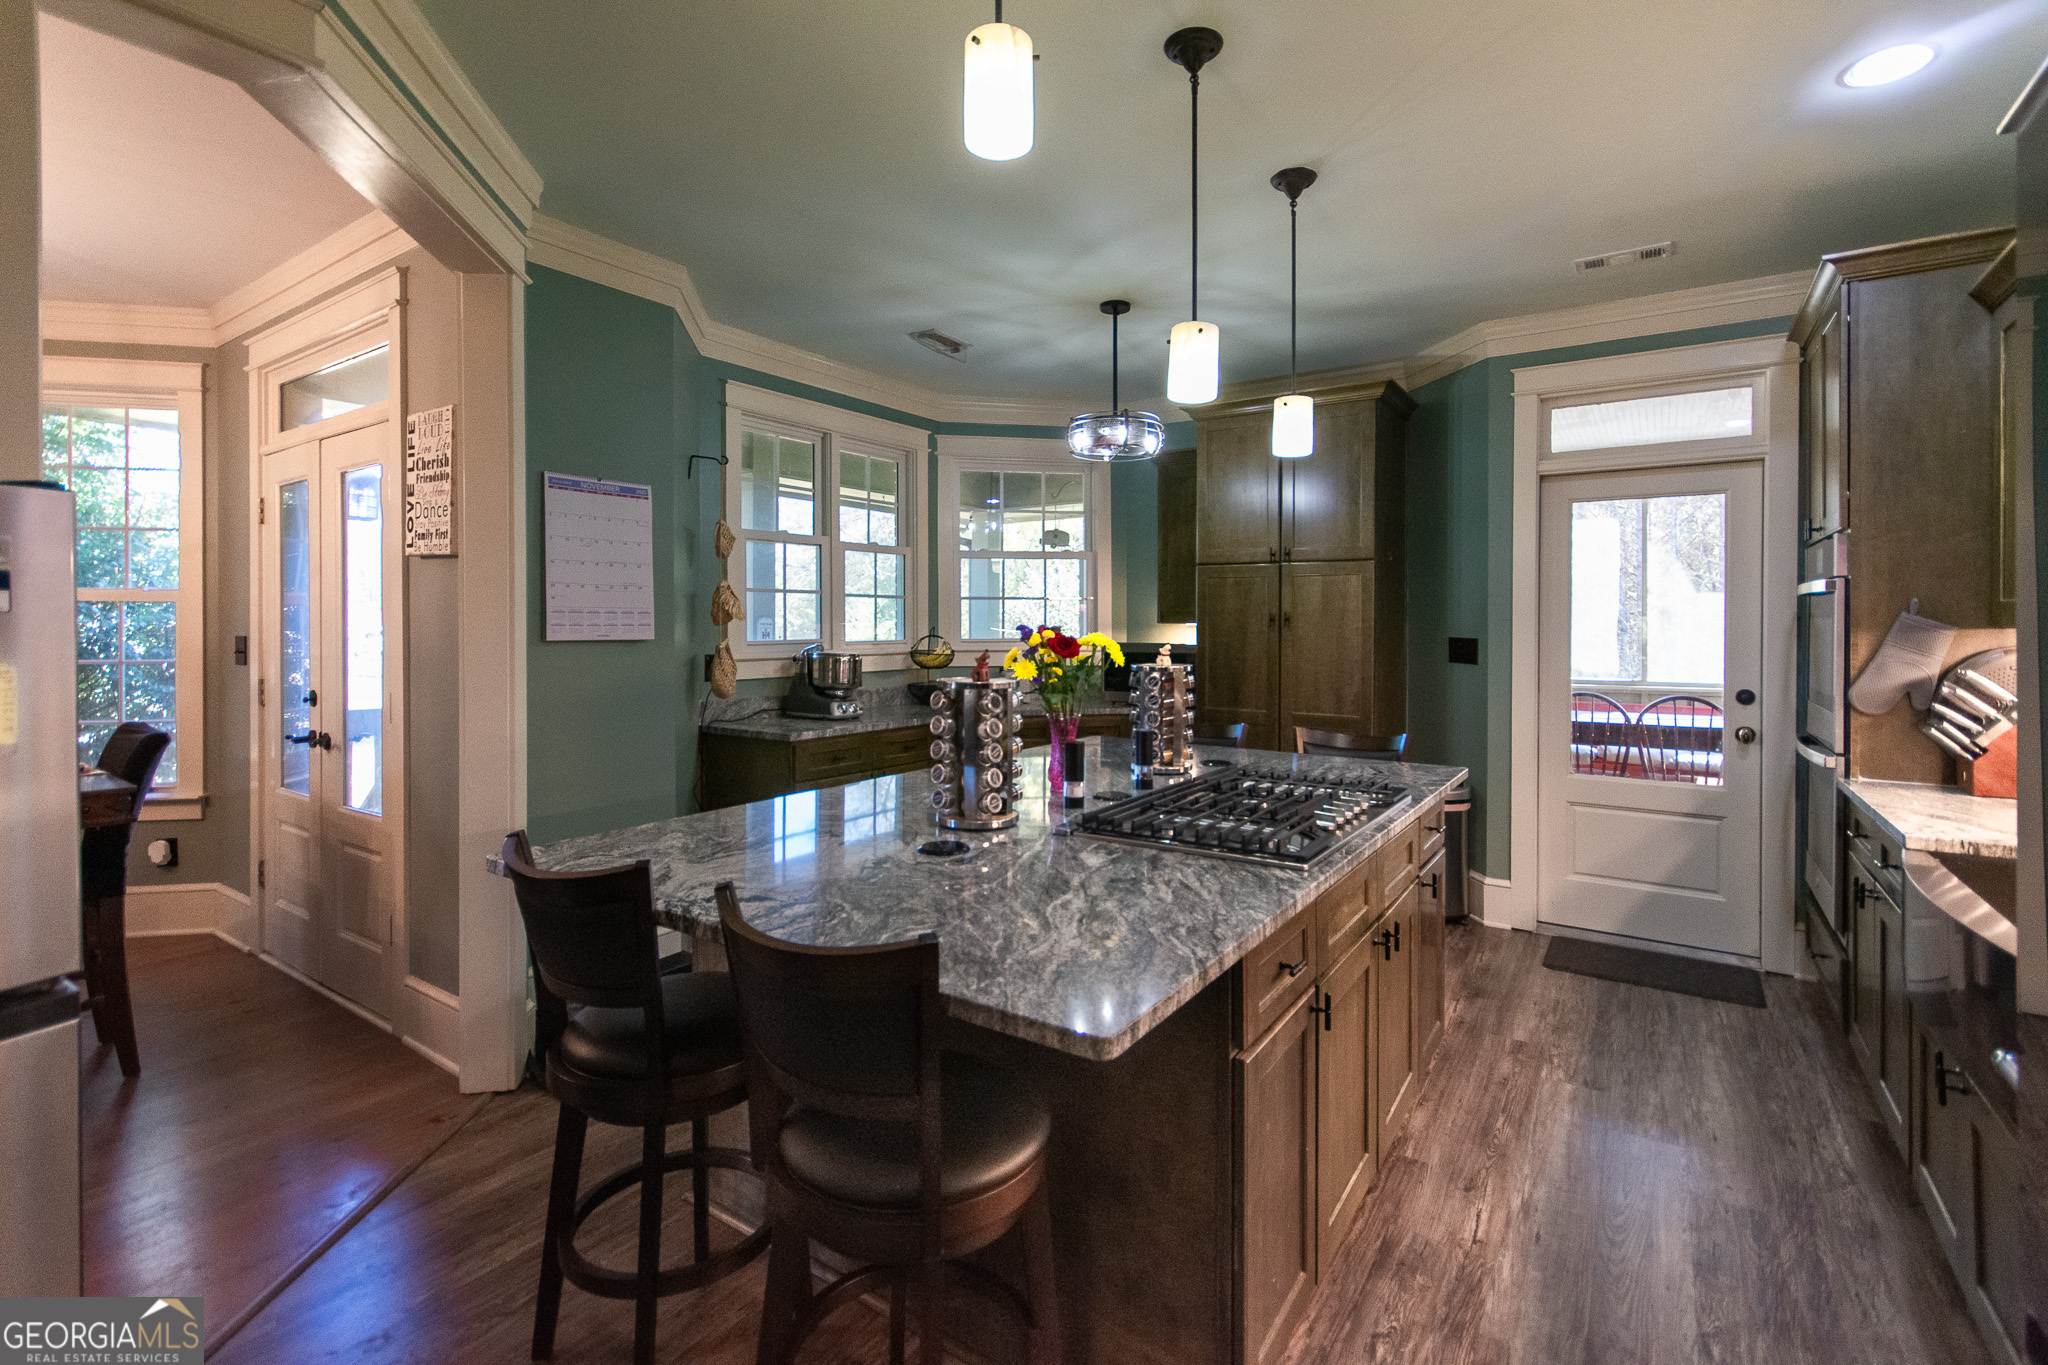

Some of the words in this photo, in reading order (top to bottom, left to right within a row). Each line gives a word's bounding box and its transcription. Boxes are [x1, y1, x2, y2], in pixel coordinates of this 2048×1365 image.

[417, 410, 444, 427] LAUGH
[418, 423, 444, 441] LOUD
[407, 420, 416, 473] LIFE
[415, 453, 450, 472] Cherish
[416, 470, 450, 484] Friendship
[580, 481, 620, 493] NOVEMBER
[406, 483, 415, 549] LOVE
[414, 501, 449, 520] Dance
[414, 528, 434, 544] Family
[434, 527, 449, 541] First
[413, 541, 422, 553] Be
[423, 540, 449, 552] Humble
